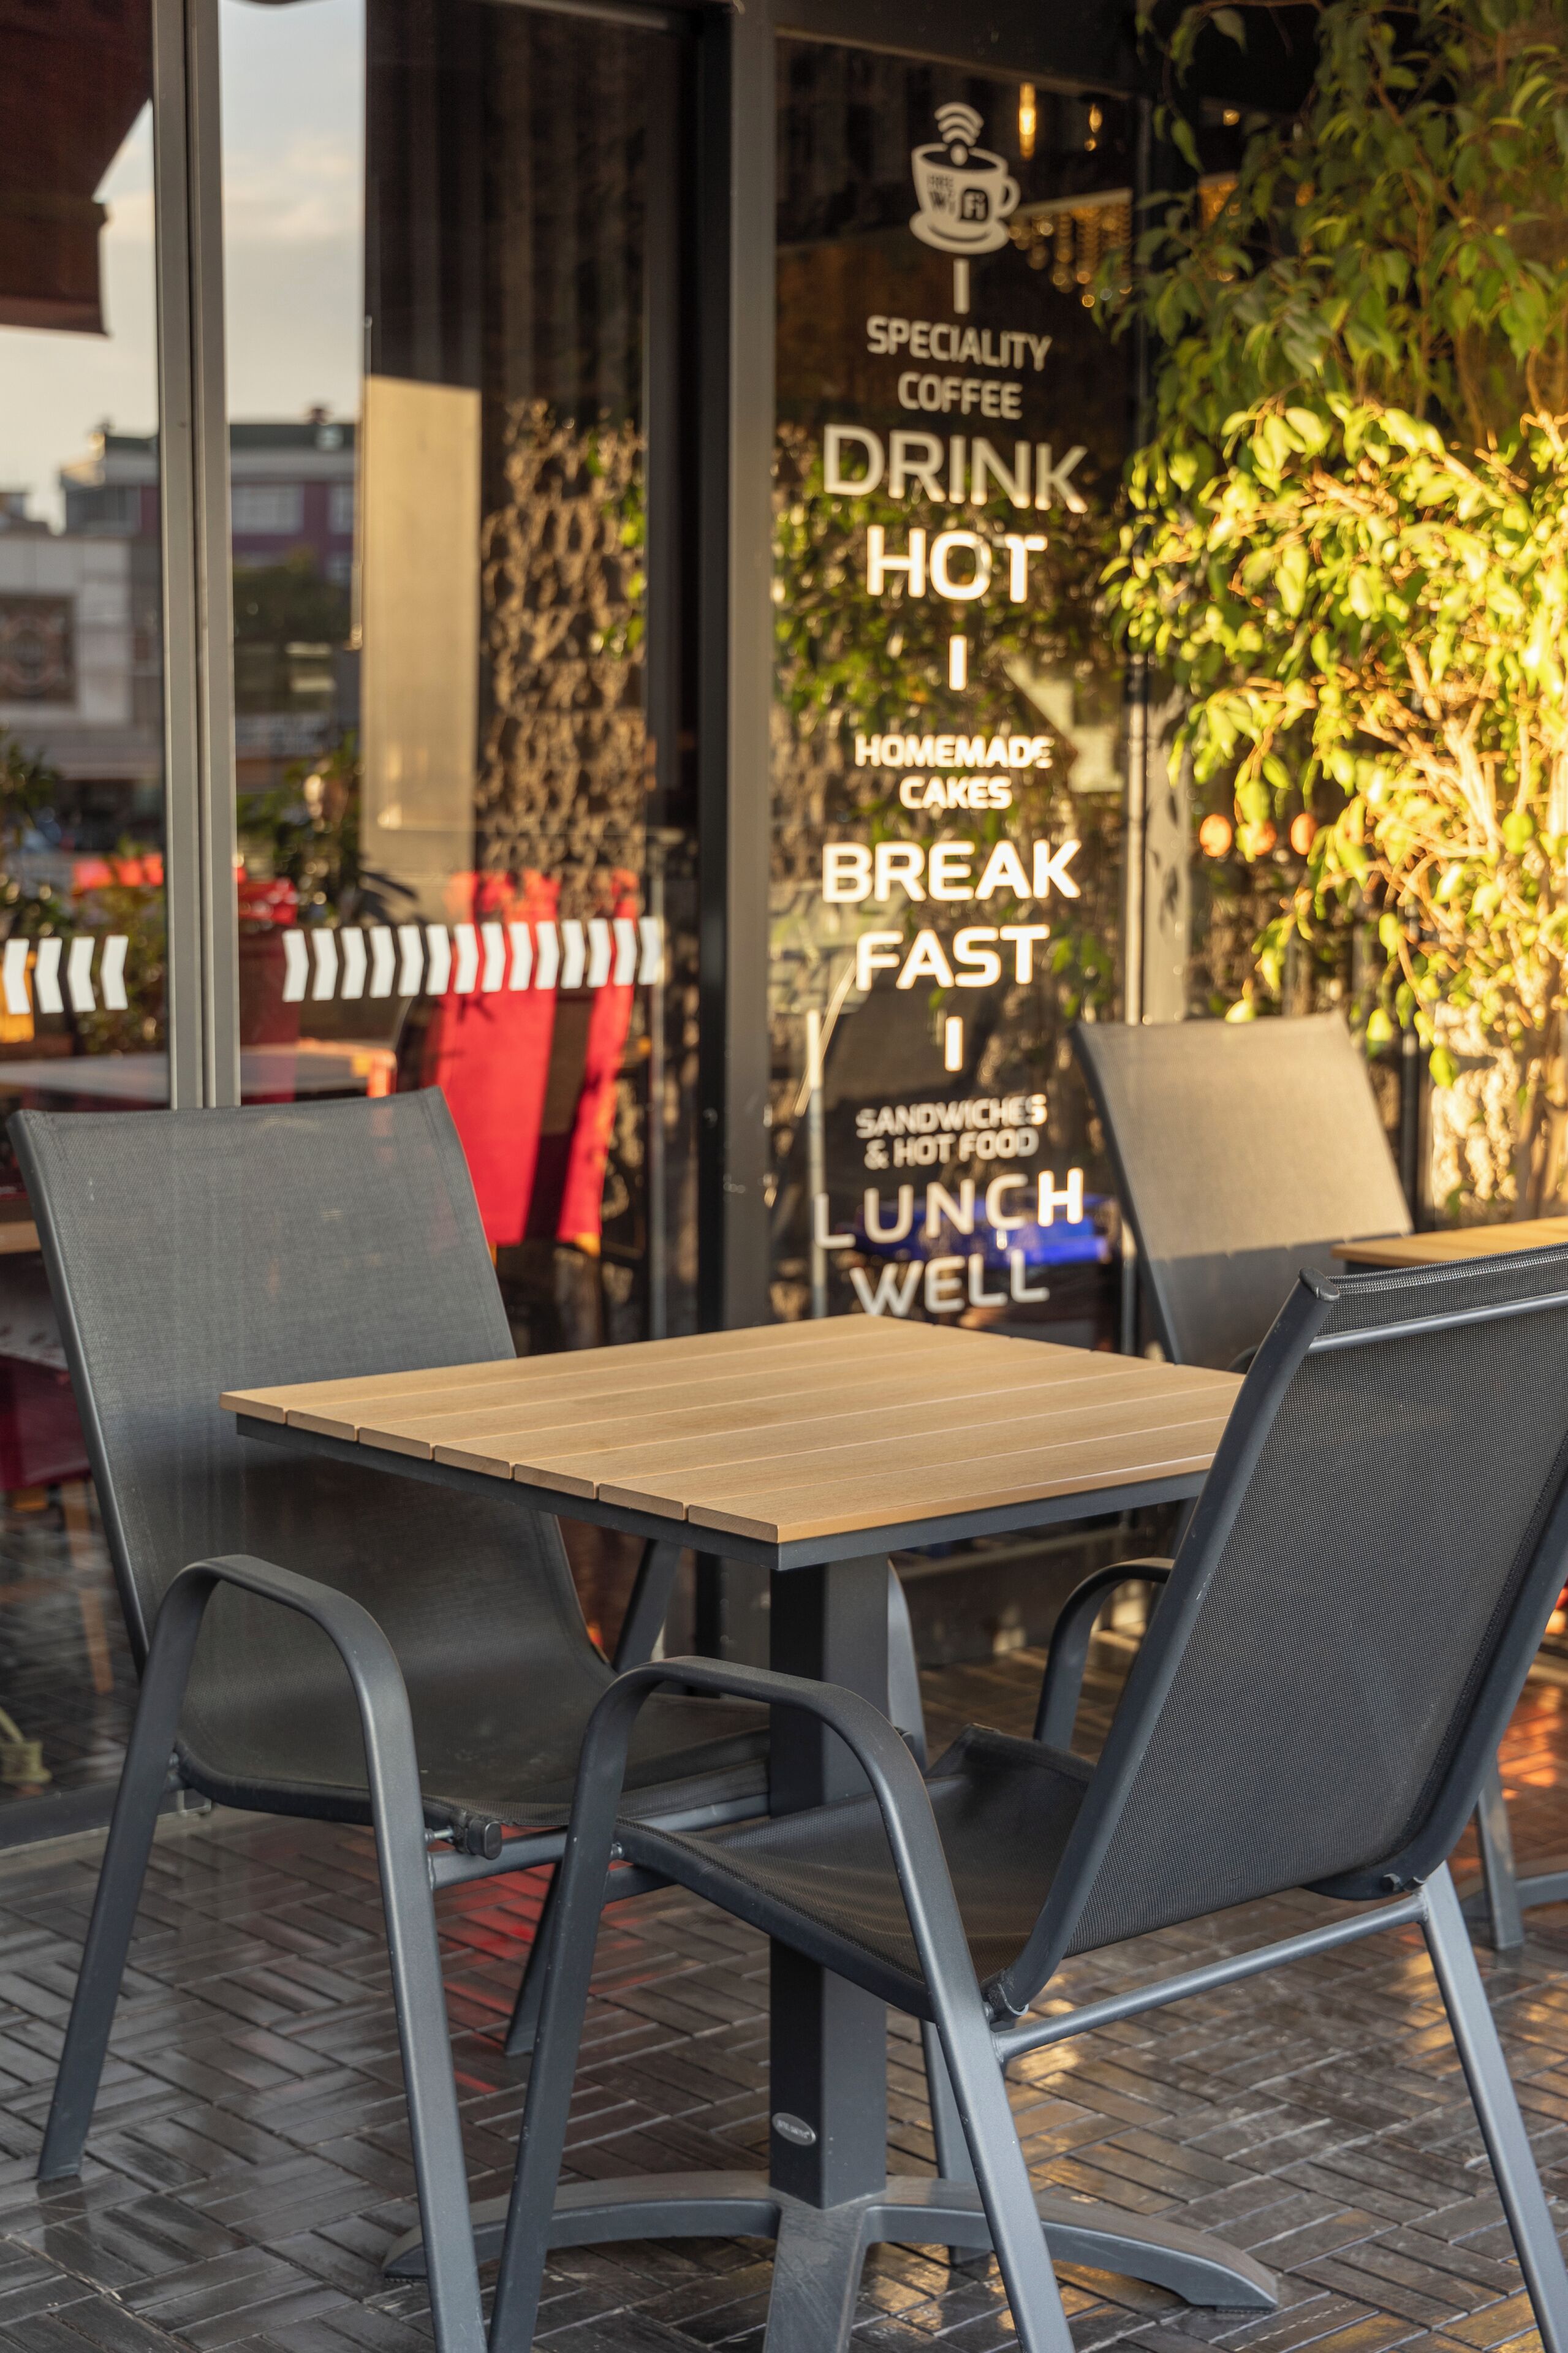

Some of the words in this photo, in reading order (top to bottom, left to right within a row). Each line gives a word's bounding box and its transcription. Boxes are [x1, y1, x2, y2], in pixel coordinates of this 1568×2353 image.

[866, 314, 1053, 371] SPECIALITY
[897, 371, 1023, 420] COFFEE
[823, 424, 1088, 513] DRINK
[866, 525, 1048, 604] HOT
[855, 735, 1053, 768] HOMEMADE
[900, 776, 1012, 809] CAKES
[822, 840, 1081, 903] BREAK
[855, 924, 1050, 991] FAST
[856, 1094, 1047, 1139] SANDWICHES
[864, 1140, 889, 1170] &
[893, 1133, 955, 1167] HOT
[959, 1127, 1039, 1162] FOOD
[814, 1167, 1083, 1249] LUNCH
[850, 1249, 1050, 1317] WELL
